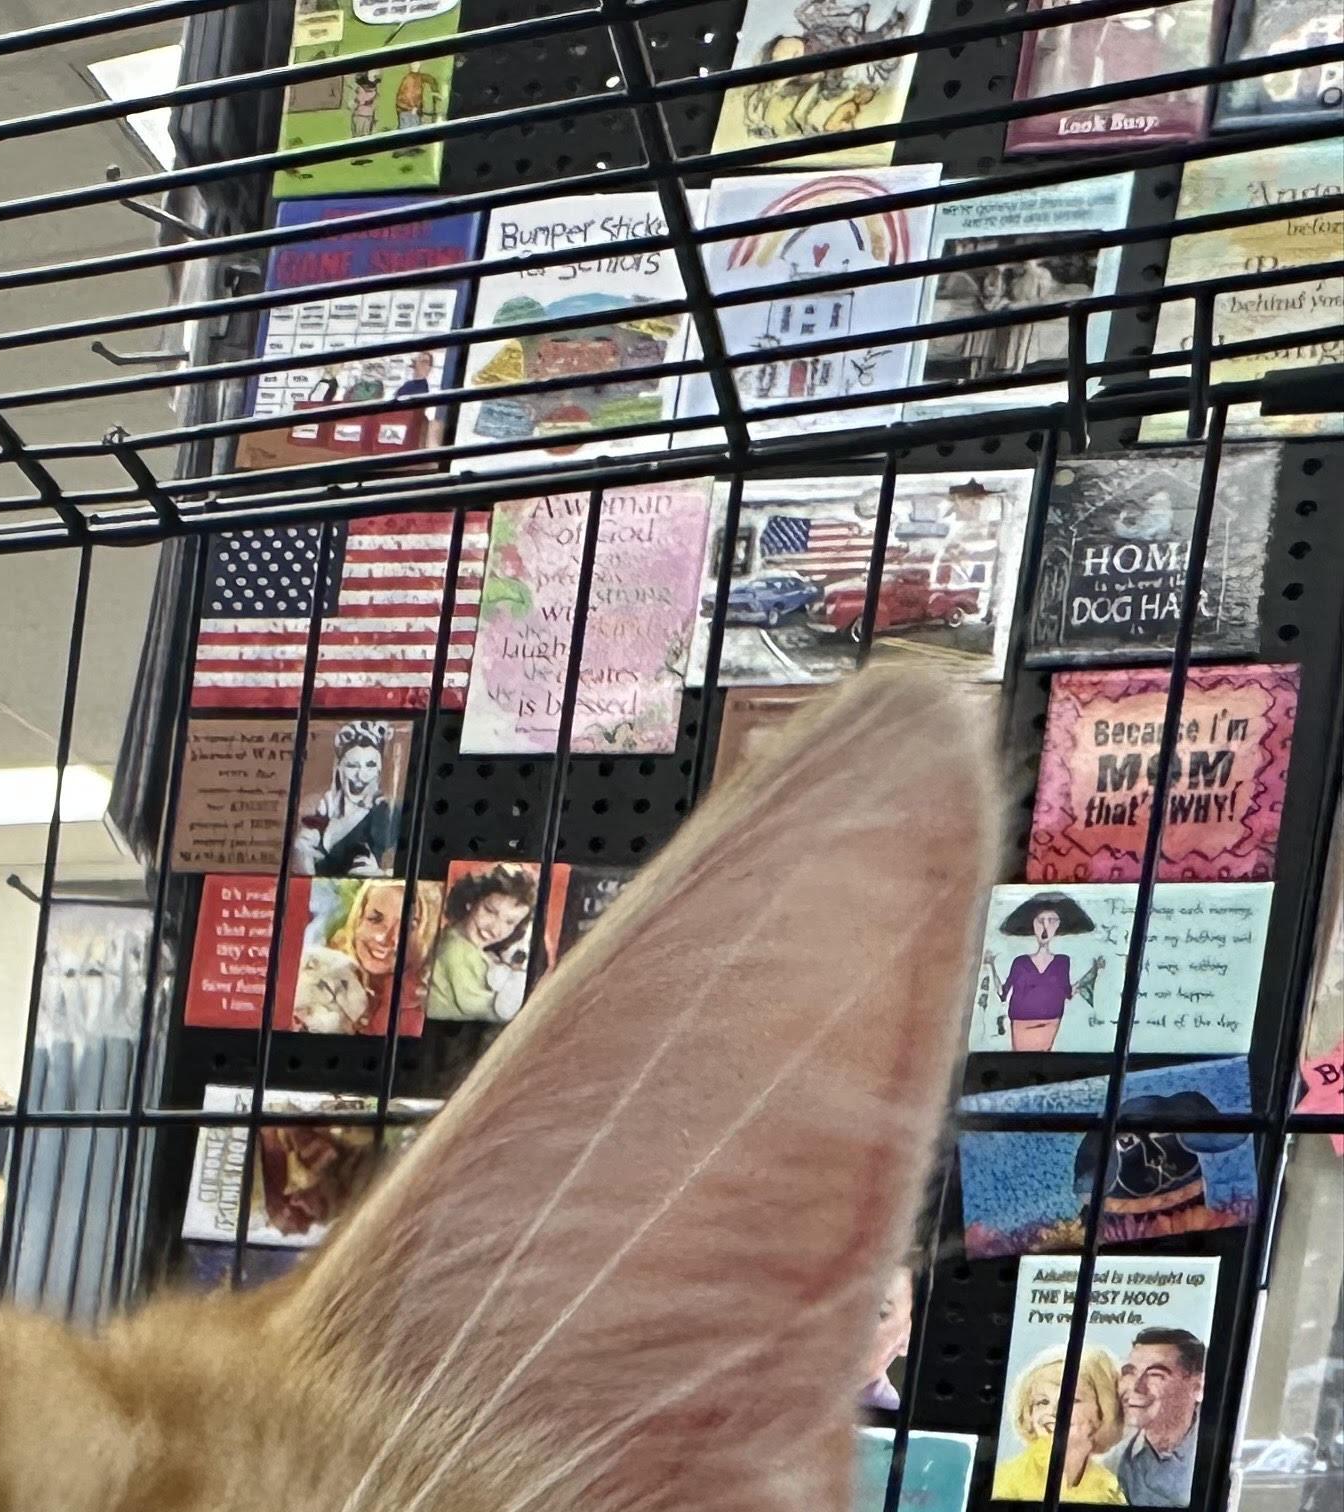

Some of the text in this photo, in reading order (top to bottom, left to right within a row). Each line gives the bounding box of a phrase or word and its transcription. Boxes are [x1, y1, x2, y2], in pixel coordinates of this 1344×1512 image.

[1057, 114, 1106, 136] Look
[501, 218, 596, 252] Bumper
[1070, 589, 1213, 627] DOG HAR
[1209, 707, 1250, 744] I'm
[1169, 782, 1238, 826] WHY!
[1030, 1288, 1063, 1305] THE
[1122, 1290, 1171, 1306] HOOD
